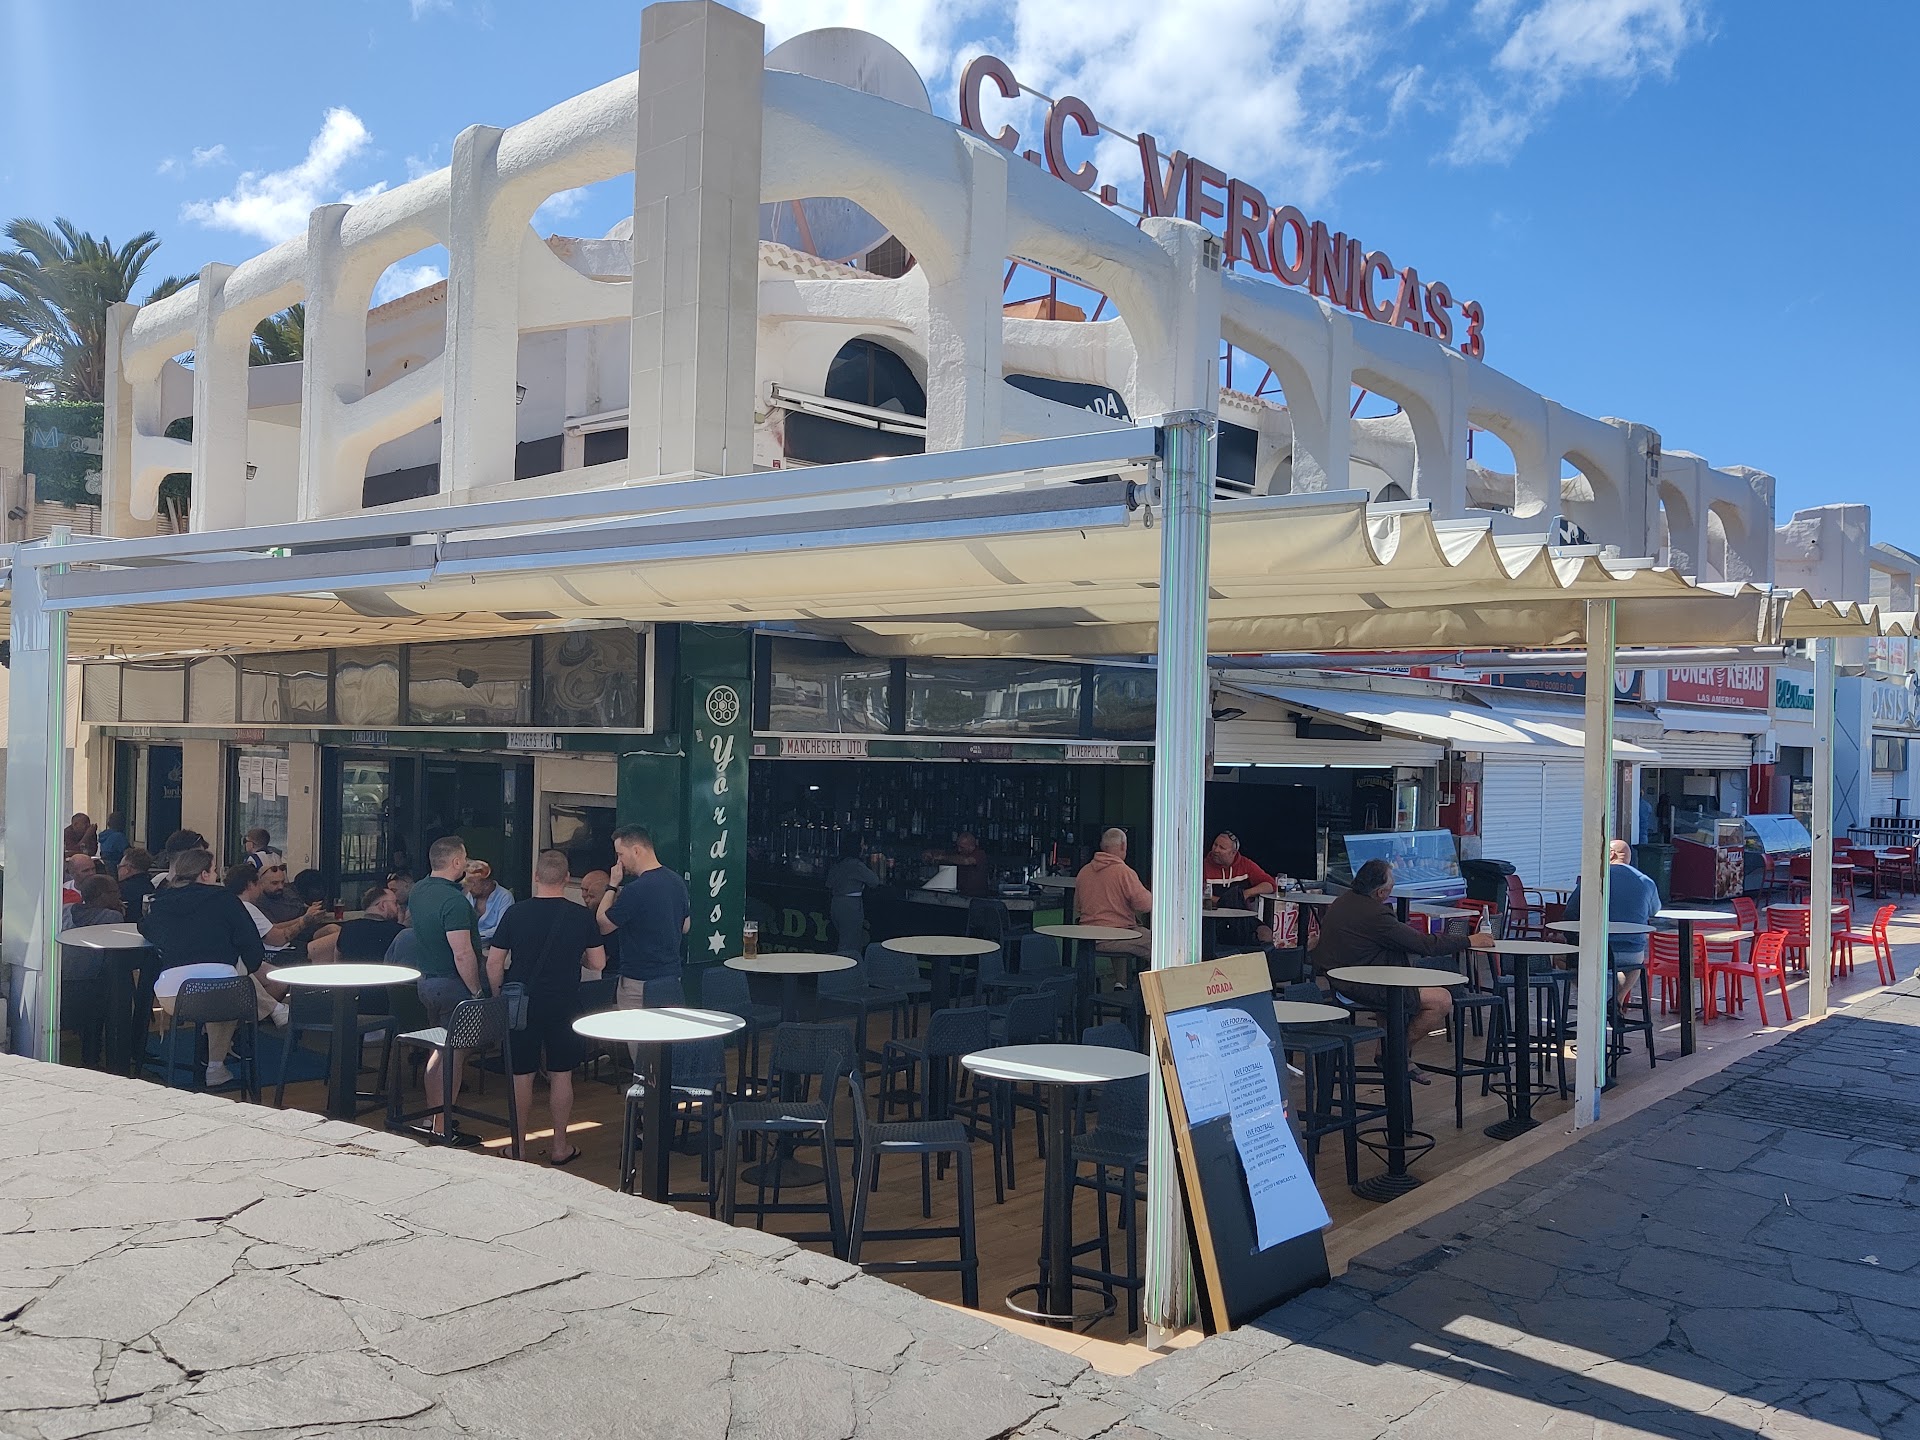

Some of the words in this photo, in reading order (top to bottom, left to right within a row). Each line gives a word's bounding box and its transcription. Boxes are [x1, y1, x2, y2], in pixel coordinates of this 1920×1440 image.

[960, 55, 1117, 206] C.C.
[1138, 133, 1453, 345] VERONICAS
[1461, 301, 1485, 361] 3
[1526, 680, 1544, 689] SIMPLY
[1727, 667, 1764, 692] KEBAB
[1697, 694, 1710, 703] LAS
[1711, 695, 1744, 706] AMERICAS
[1872, 687, 1905, 721] OASIS
[787, 740, 842, 754] MANCHESTER
[847, 741, 863, 755] UTD
[1071, 745, 1103, 758] LIVERPOOL
[710, 735, 735, 923] Yordys
[1727, 850, 1742, 862] PIZZA
[1273, 909, 1321, 940] PIZA
[1206, 982, 1234, 996] DORADA
[1220, 1019, 1230, 1028] LIVE
[1233, 1067, 1243, 1077] LIVE
[1242, 1062, 1263, 1073] FOOTBALL
[1245, 1128, 1254, 1137] LIVE
[1254, 1122, 1274, 1133] FOOTBALL
